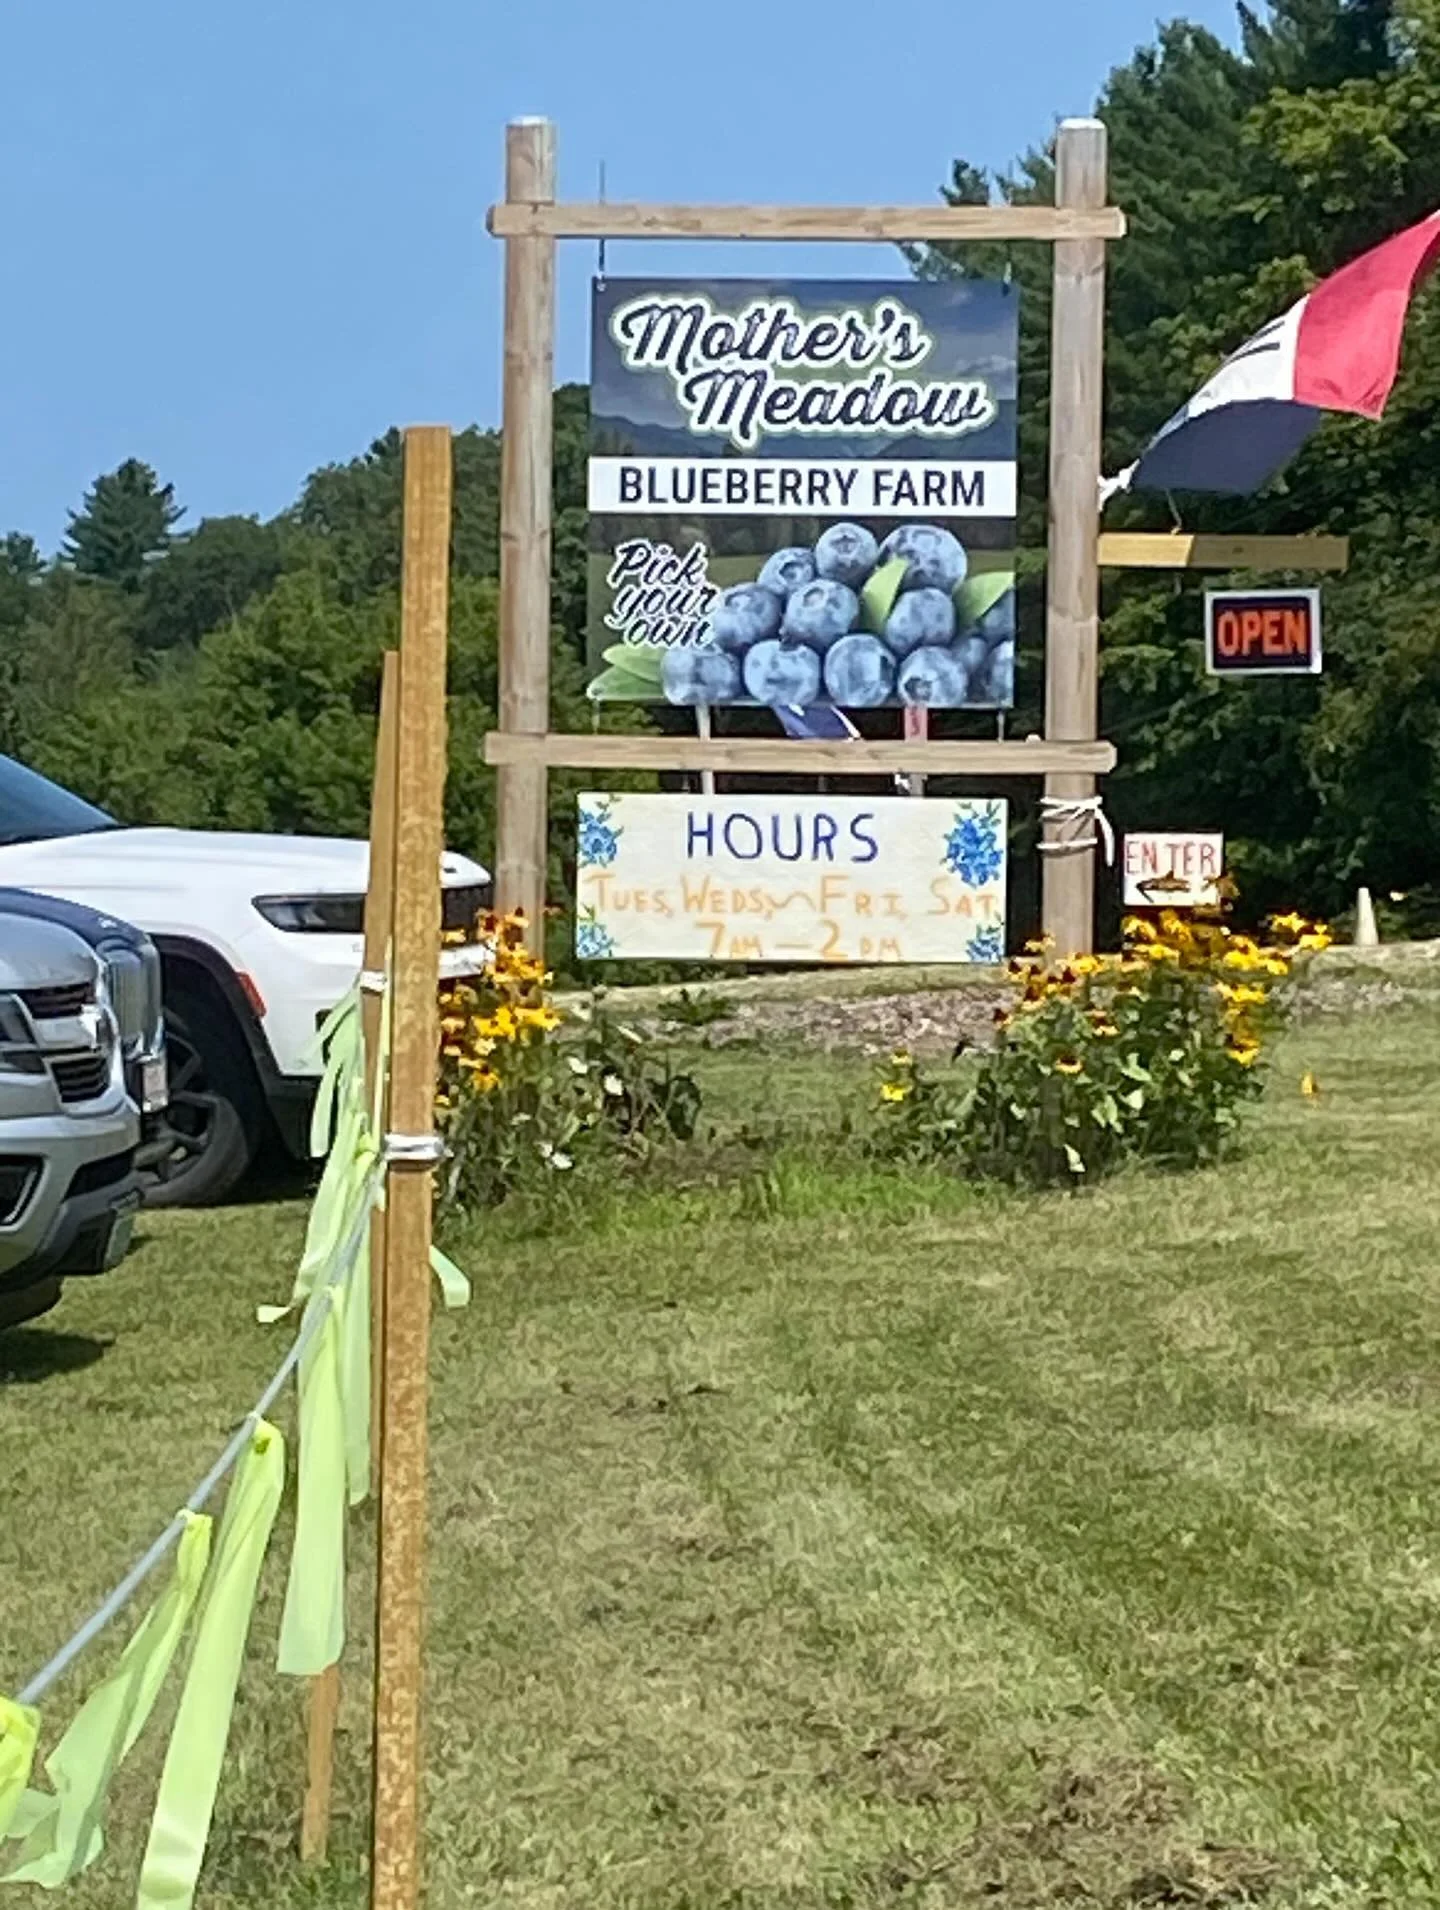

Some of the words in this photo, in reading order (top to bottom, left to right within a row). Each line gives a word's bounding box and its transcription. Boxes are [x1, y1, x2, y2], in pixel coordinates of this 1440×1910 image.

[619, 301, 926, 376] Mother's
[682, 367, 989, 442] Meadow
[618, 466, 859, 505] BLUEBERRY
[871, 468, 986, 507] FARM
[608, 541, 706, 587] Pick
[604, 585, 718, 628] your
[626, 618, 712, 648] own
[1217, 610, 1308, 657] OPEN
[686, 812, 879, 863] HOURS
[1125, 840, 1216, 876] ENTER
